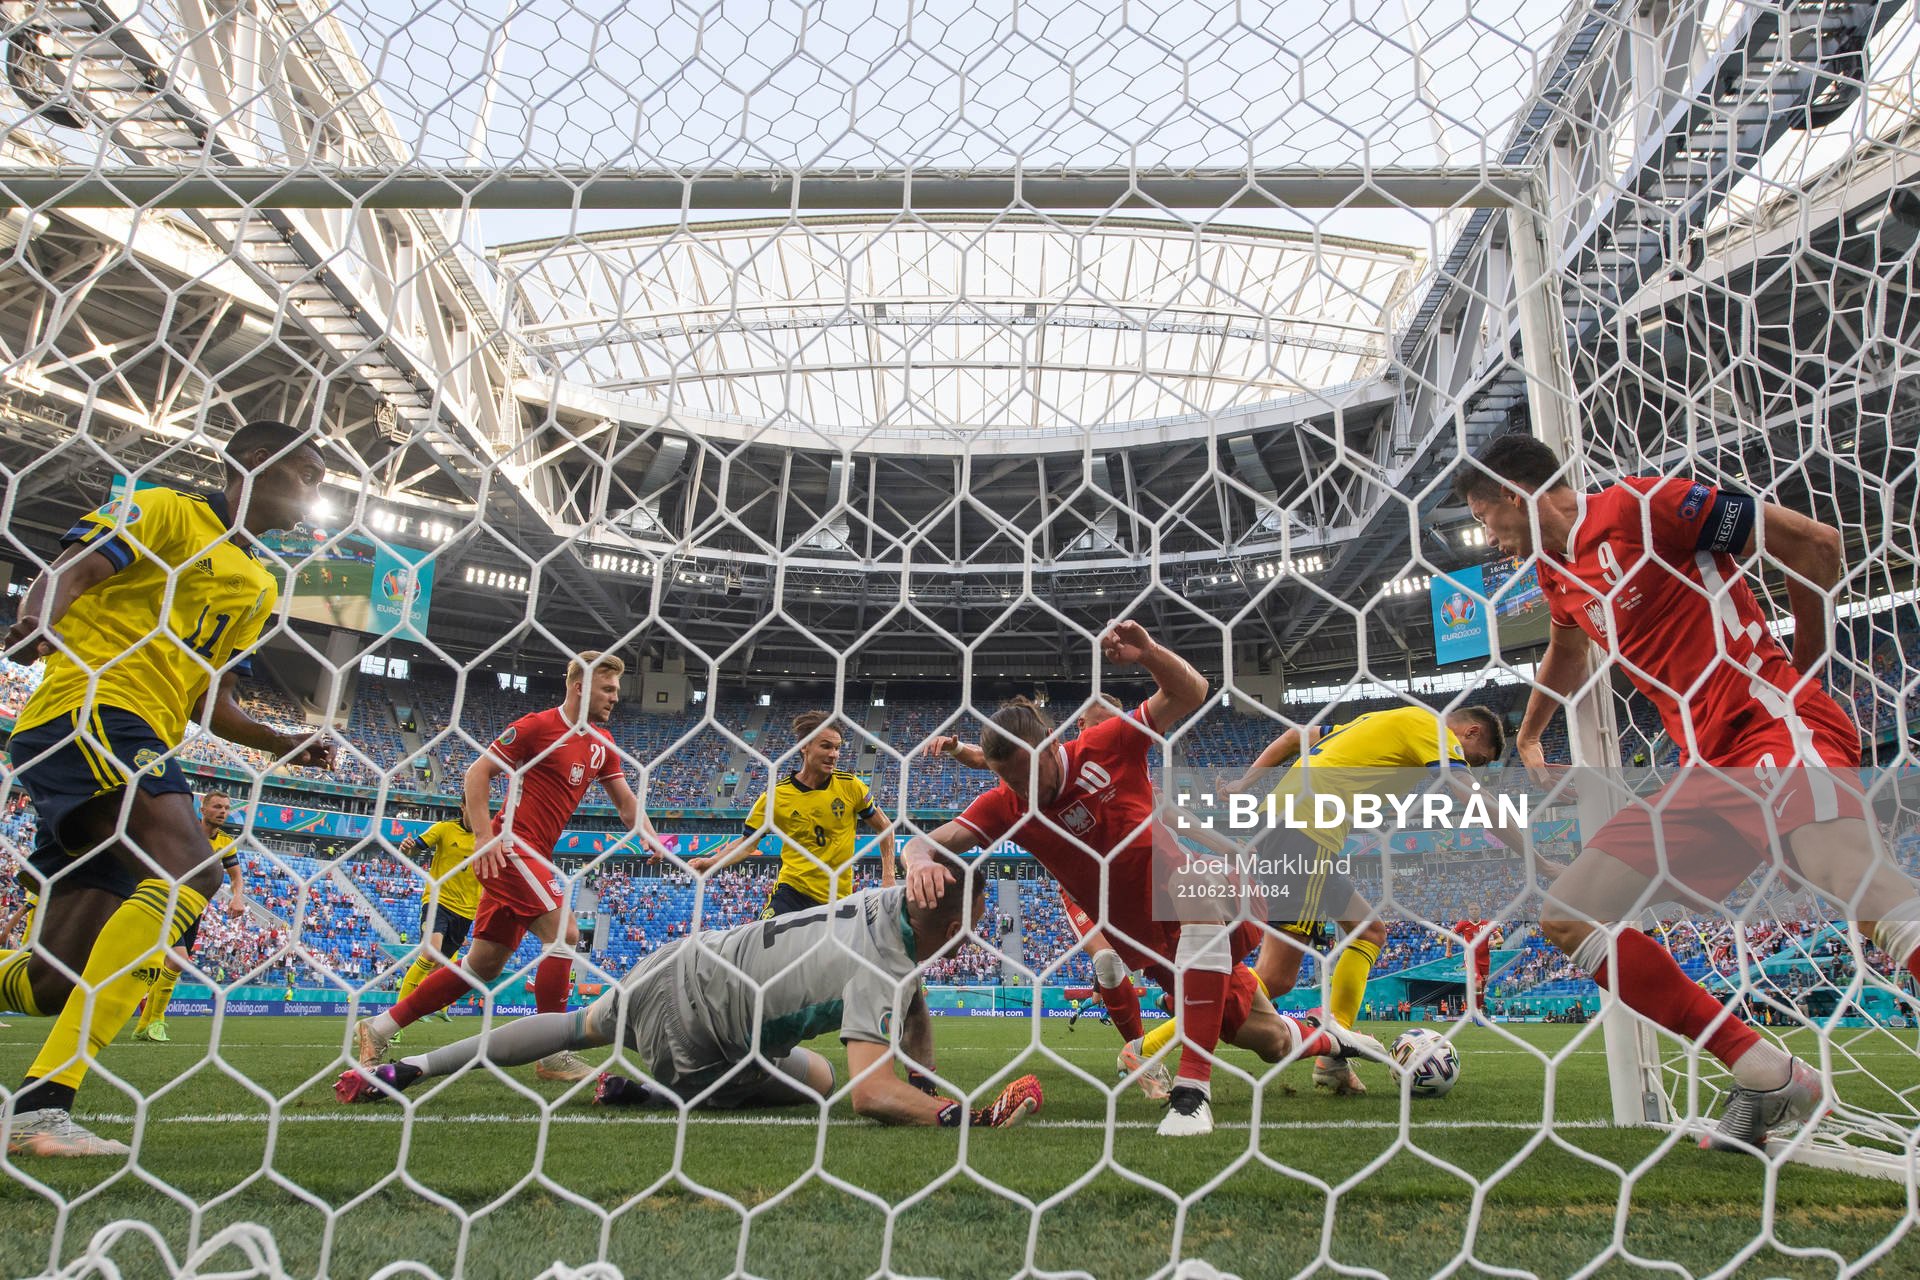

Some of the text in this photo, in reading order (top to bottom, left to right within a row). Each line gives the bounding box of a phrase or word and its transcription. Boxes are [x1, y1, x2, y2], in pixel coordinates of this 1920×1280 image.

[1718, 501, 1739, 542] RESPECT
[1490, 563, 1509, 574] 16:42
[1597, 541, 1624, 587] 9
[376, 604, 422, 620] EURO20
[182, 604, 231, 659] 11
[590, 743, 606, 769] 21
[1074, 760, 1112, 795] 10
[814, 825, 826, 847] 8
[226, 1002, 269, 1015] Booking.com
[284, 1003, 322, 1014] Booking.com
[496, 1005, 538, 1016] Booking.c
[970, 1008, 1024, 1018] Booking.com
